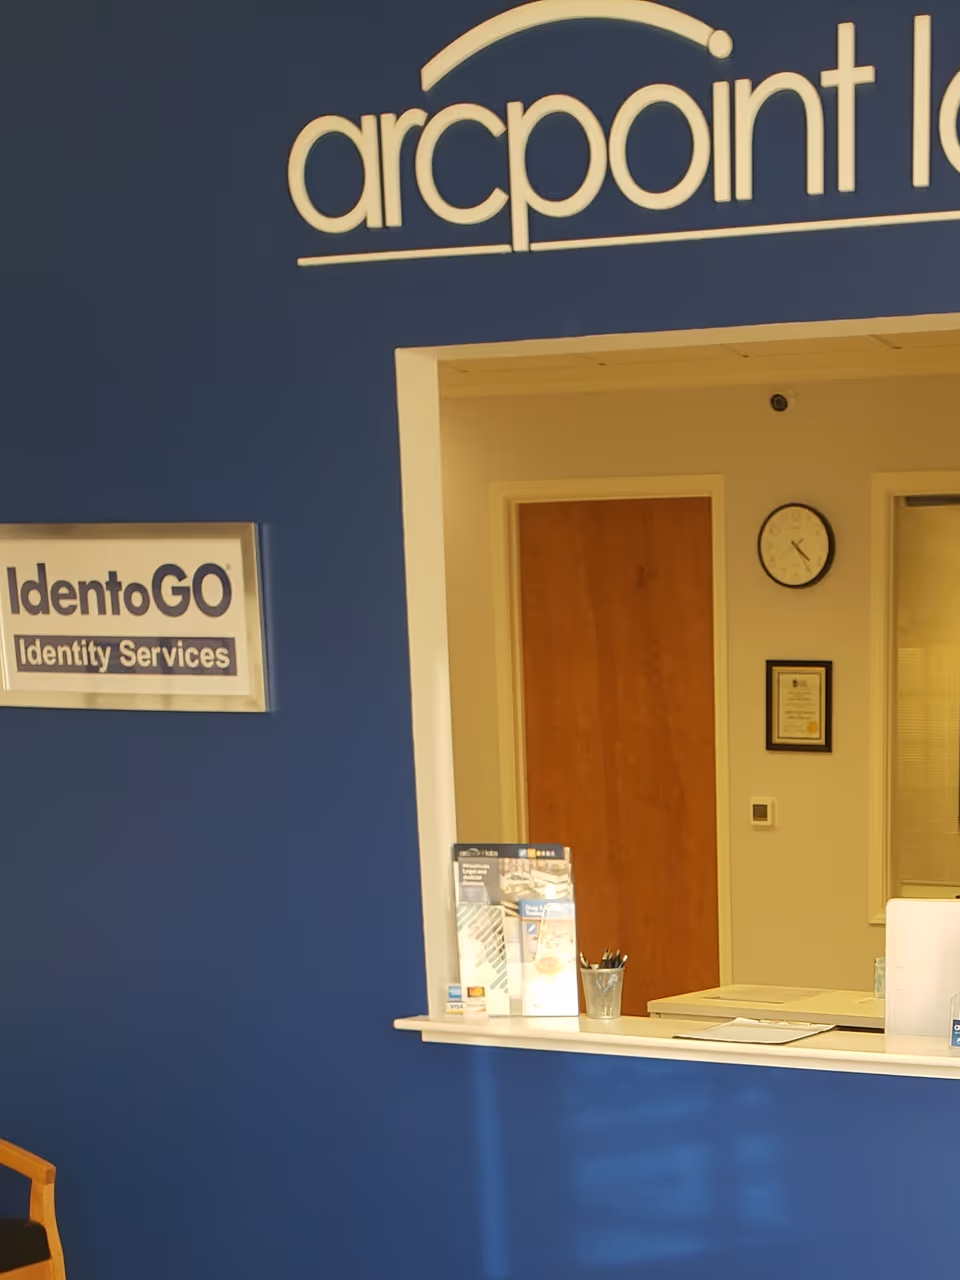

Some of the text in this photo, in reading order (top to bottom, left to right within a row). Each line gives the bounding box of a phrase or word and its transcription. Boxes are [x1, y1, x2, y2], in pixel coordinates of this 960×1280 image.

[287, 22, 876, 252] arcpoint
[6, 562, 232, 618] IdentoGO
[18, 638, 231, 673] Identity Services
